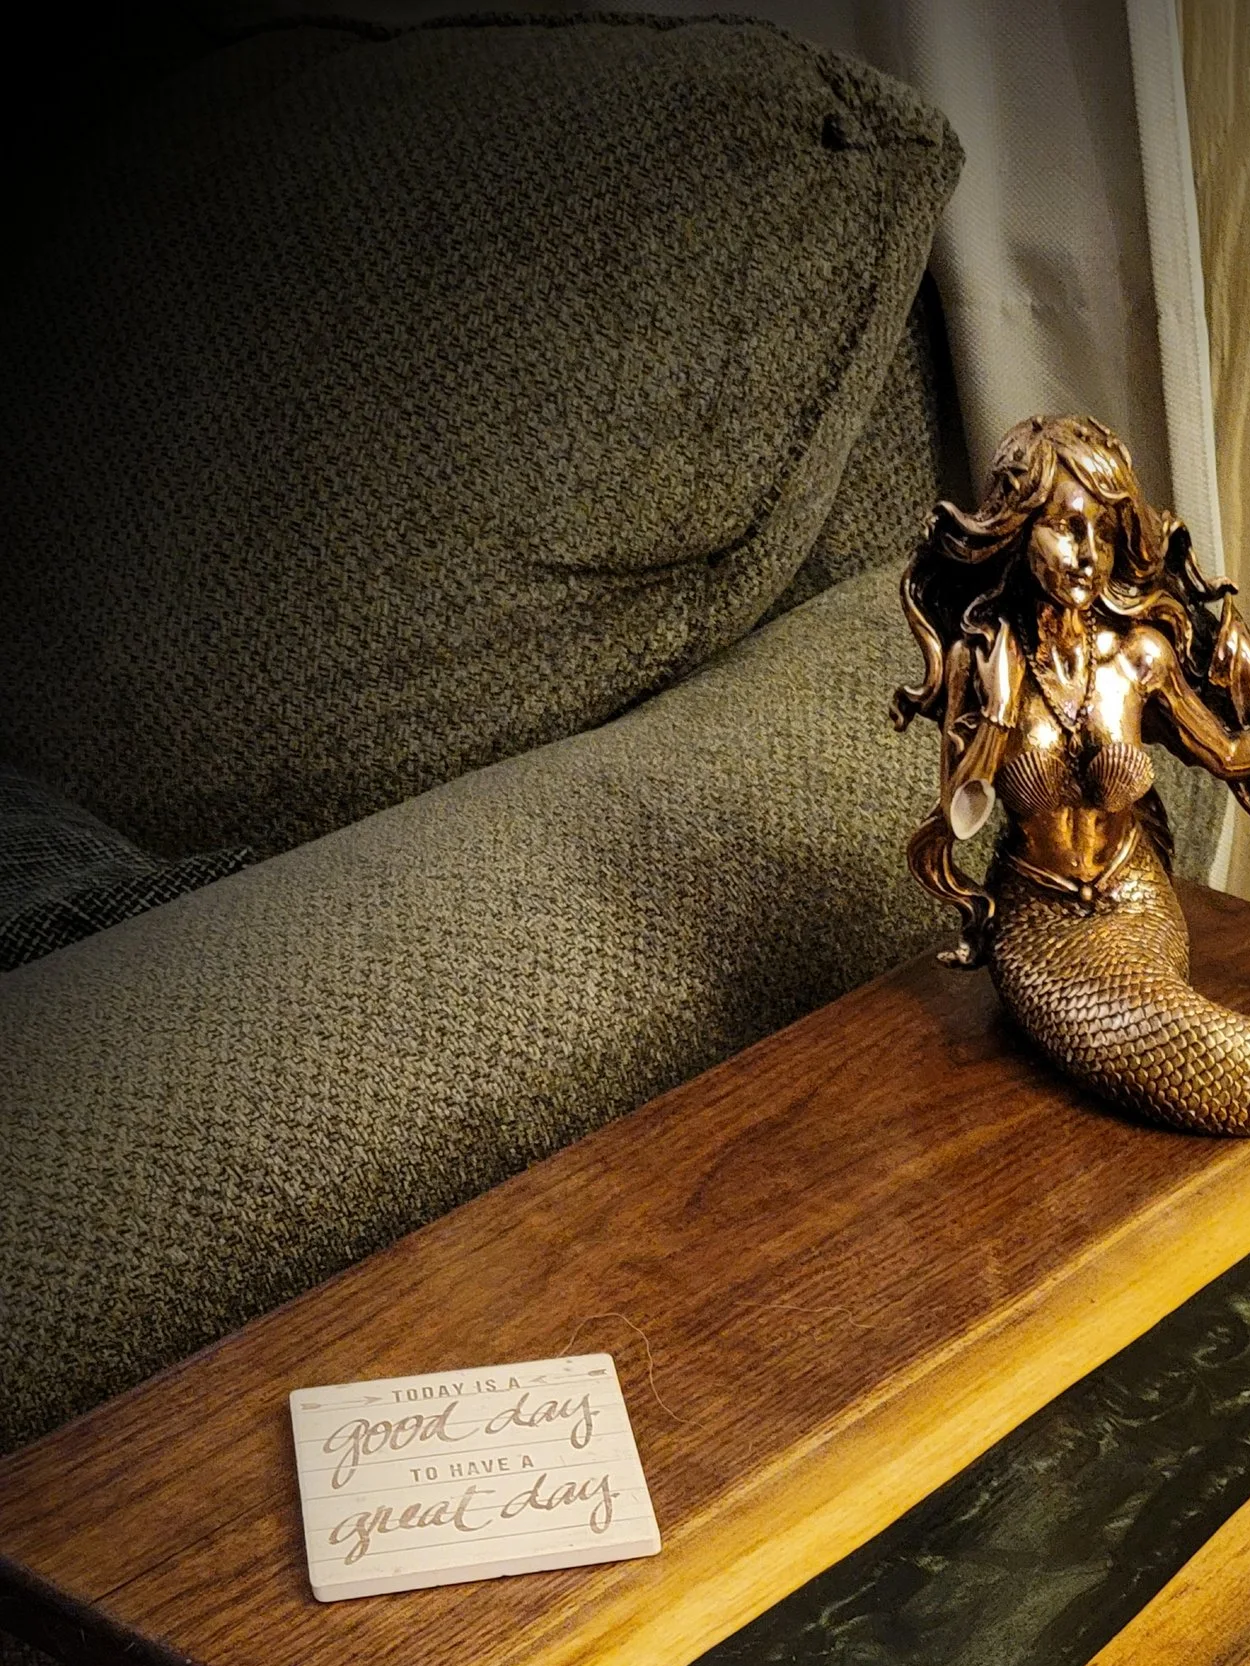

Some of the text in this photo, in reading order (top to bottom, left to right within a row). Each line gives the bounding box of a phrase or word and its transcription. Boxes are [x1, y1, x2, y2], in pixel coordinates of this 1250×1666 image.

[392, 1377, 520, 1403] TODAY IS A
[323, 1393, 600, 1490] good day
[411, 1455, 534, 1482] TO HAVE A
[329, 1473, 619, 1565] great day
